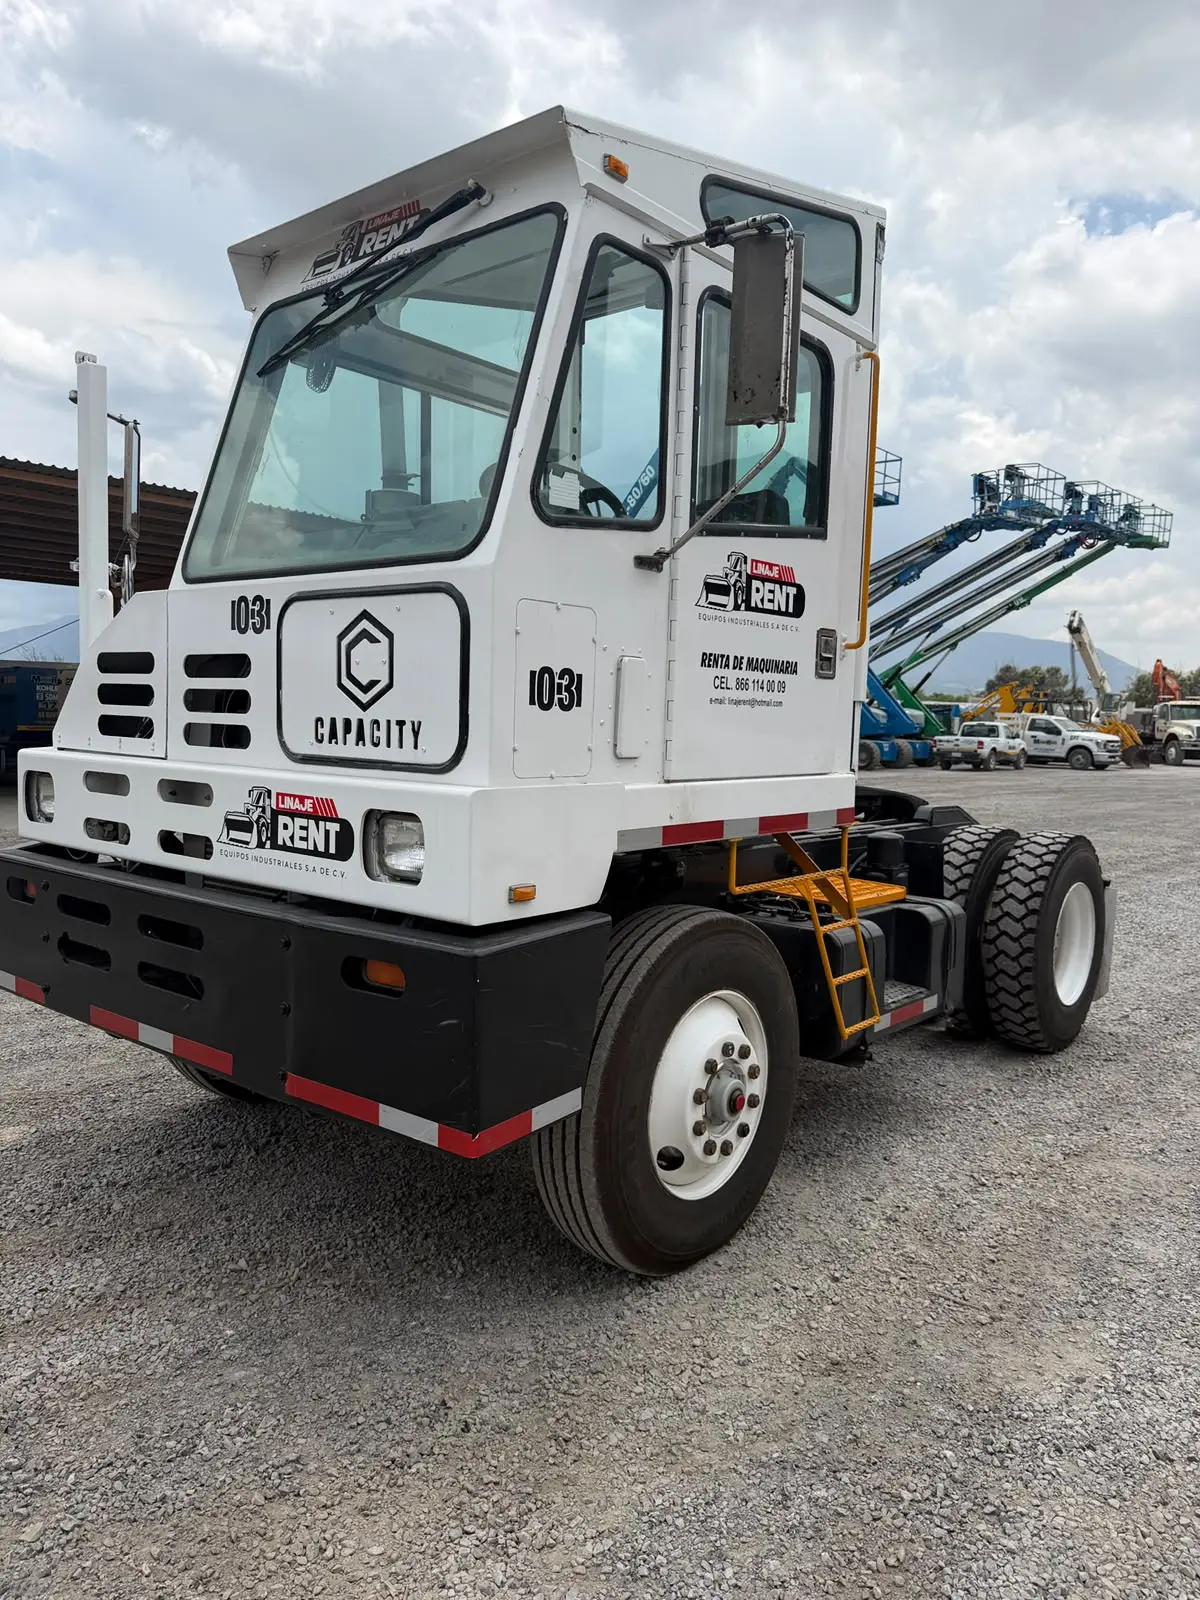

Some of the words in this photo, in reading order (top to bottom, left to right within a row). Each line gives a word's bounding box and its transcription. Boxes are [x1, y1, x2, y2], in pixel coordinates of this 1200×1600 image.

[358, 214, 420, 257] RENT
[367, 208, 402, 230] LINAJE
[626, 464, 656, 516] -80/60
[752, 561, 780, 578] LINAJE
[750, 579, 797, 613] RENT
[230, 594, 272, 635] 1031
[698, 612, 727, 623] EQUIPOS
[727, 616, 770, 629] INDUSTRIALES
[700, 651, 730, 670] RENTA
[732, 655, 745, 671] DE
[745, 656, 798, 676] MAQUINARIA
[528, 665, 583, 712] 1031
[713, 675, 733, 691] CEL.
[735, 677, 750, 692] 866
[751, 678, 765, 692] 114
[766, 679, 776, 693] 00
[776, 680, 786, 694] 09
[314, 716, 422, 751] CAPACITY
[278, 795, 314, 812] LINAJE
[277, 814, 341, 855] RENT
[219, 848, 250, 861] EQUIPOS
[251, 854, 304, 871] INDUSTRIALES
[319, 867, 330, 876] DE
[332, 869, 347, 880] C.V.
